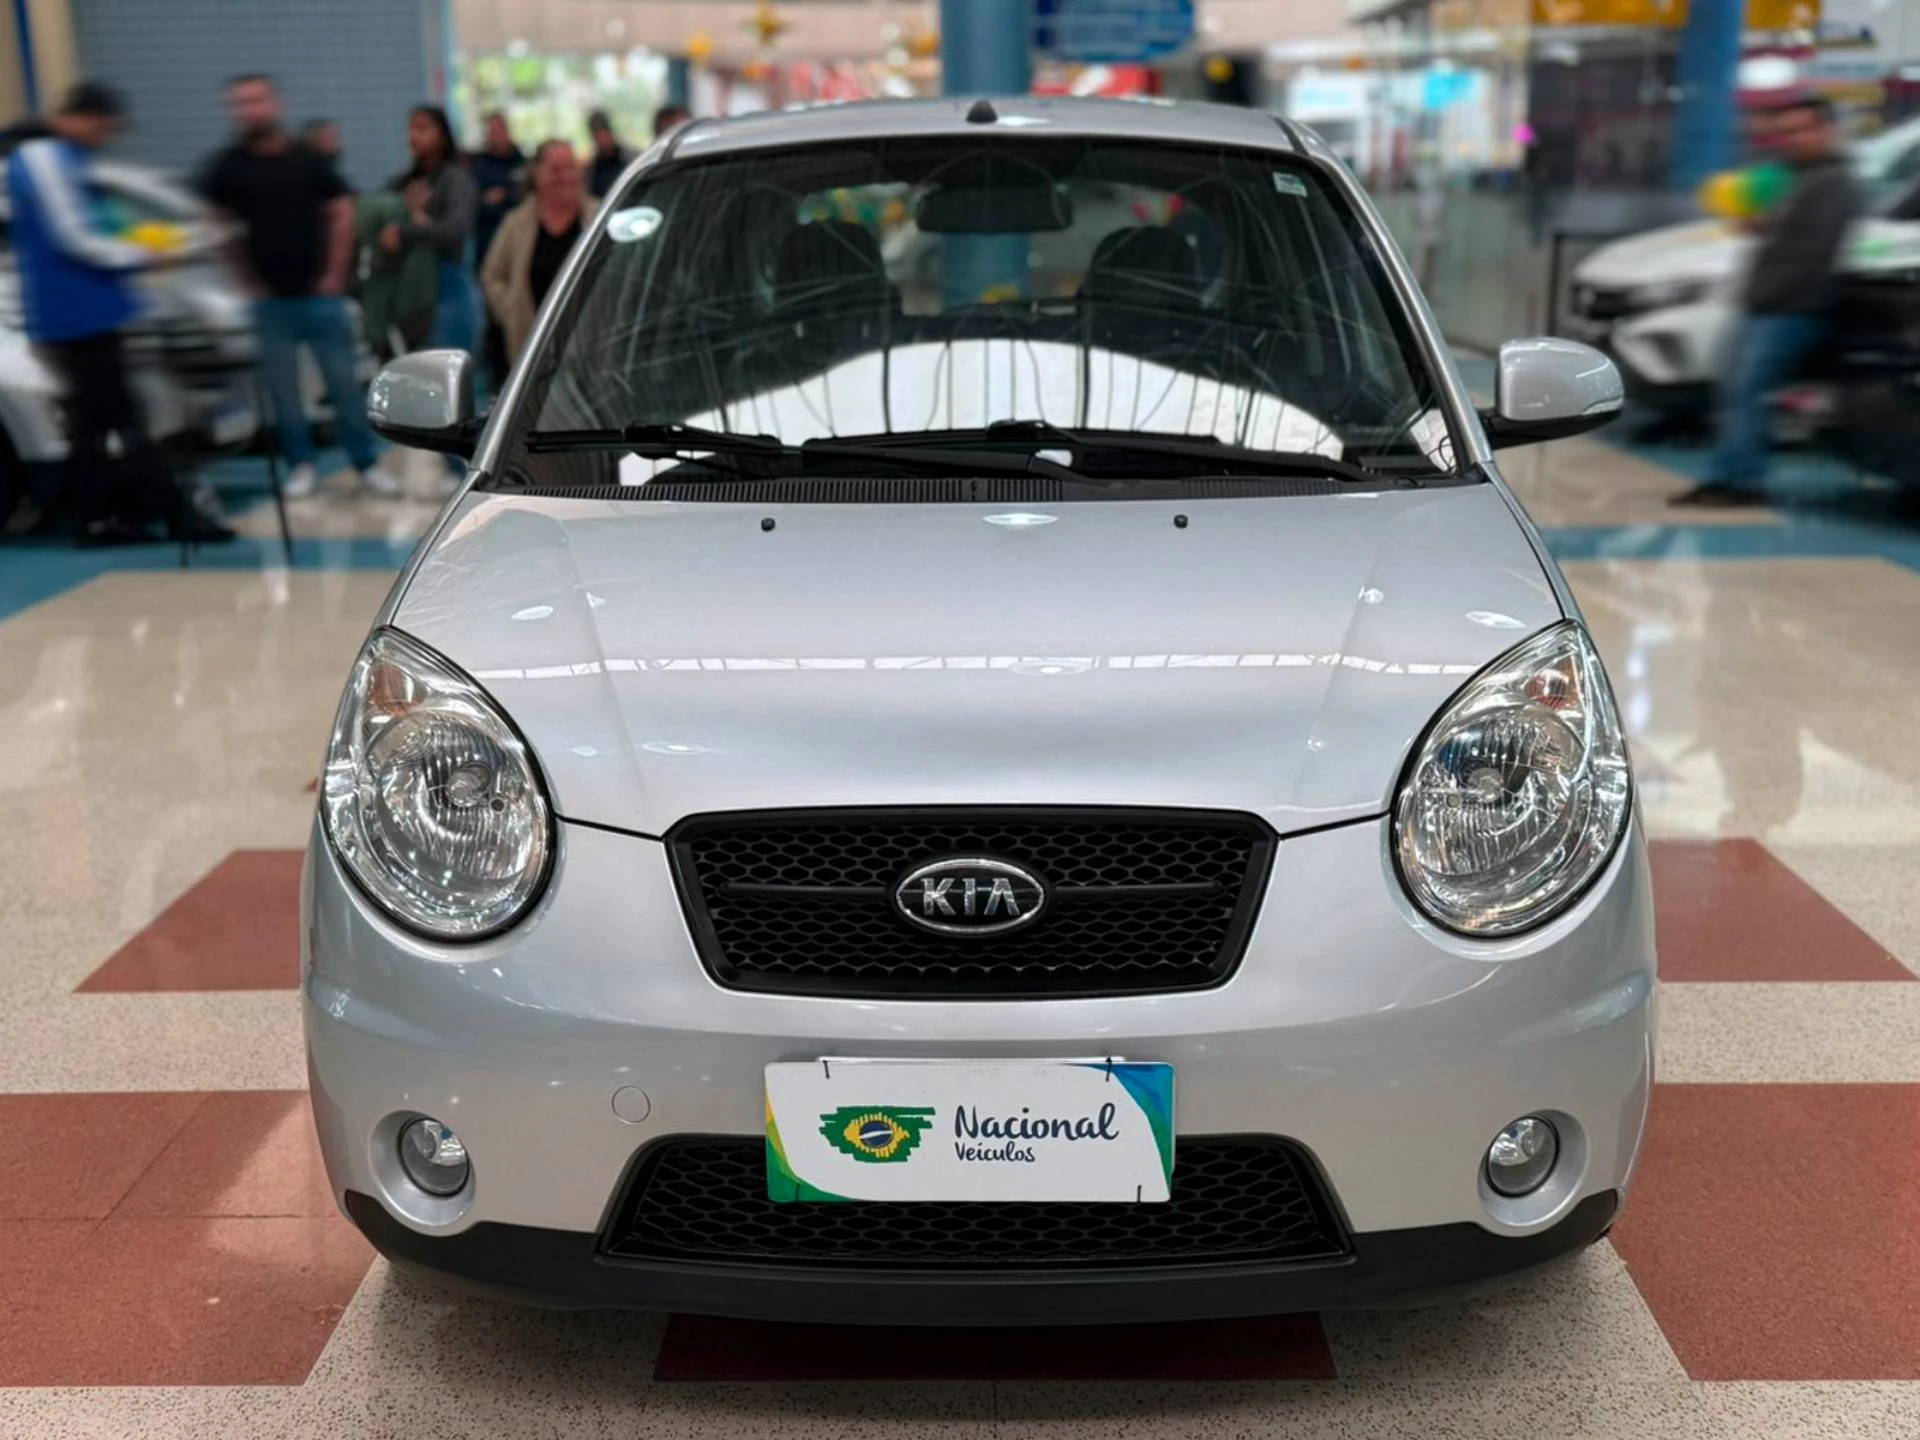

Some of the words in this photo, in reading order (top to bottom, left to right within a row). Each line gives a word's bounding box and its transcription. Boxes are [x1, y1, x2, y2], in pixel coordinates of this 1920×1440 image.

[920, 877, 1020, 915] KIA
[954, 1102, 1119, 1141] Nacional
[954, 1140, 1036, 1162] Veículos
